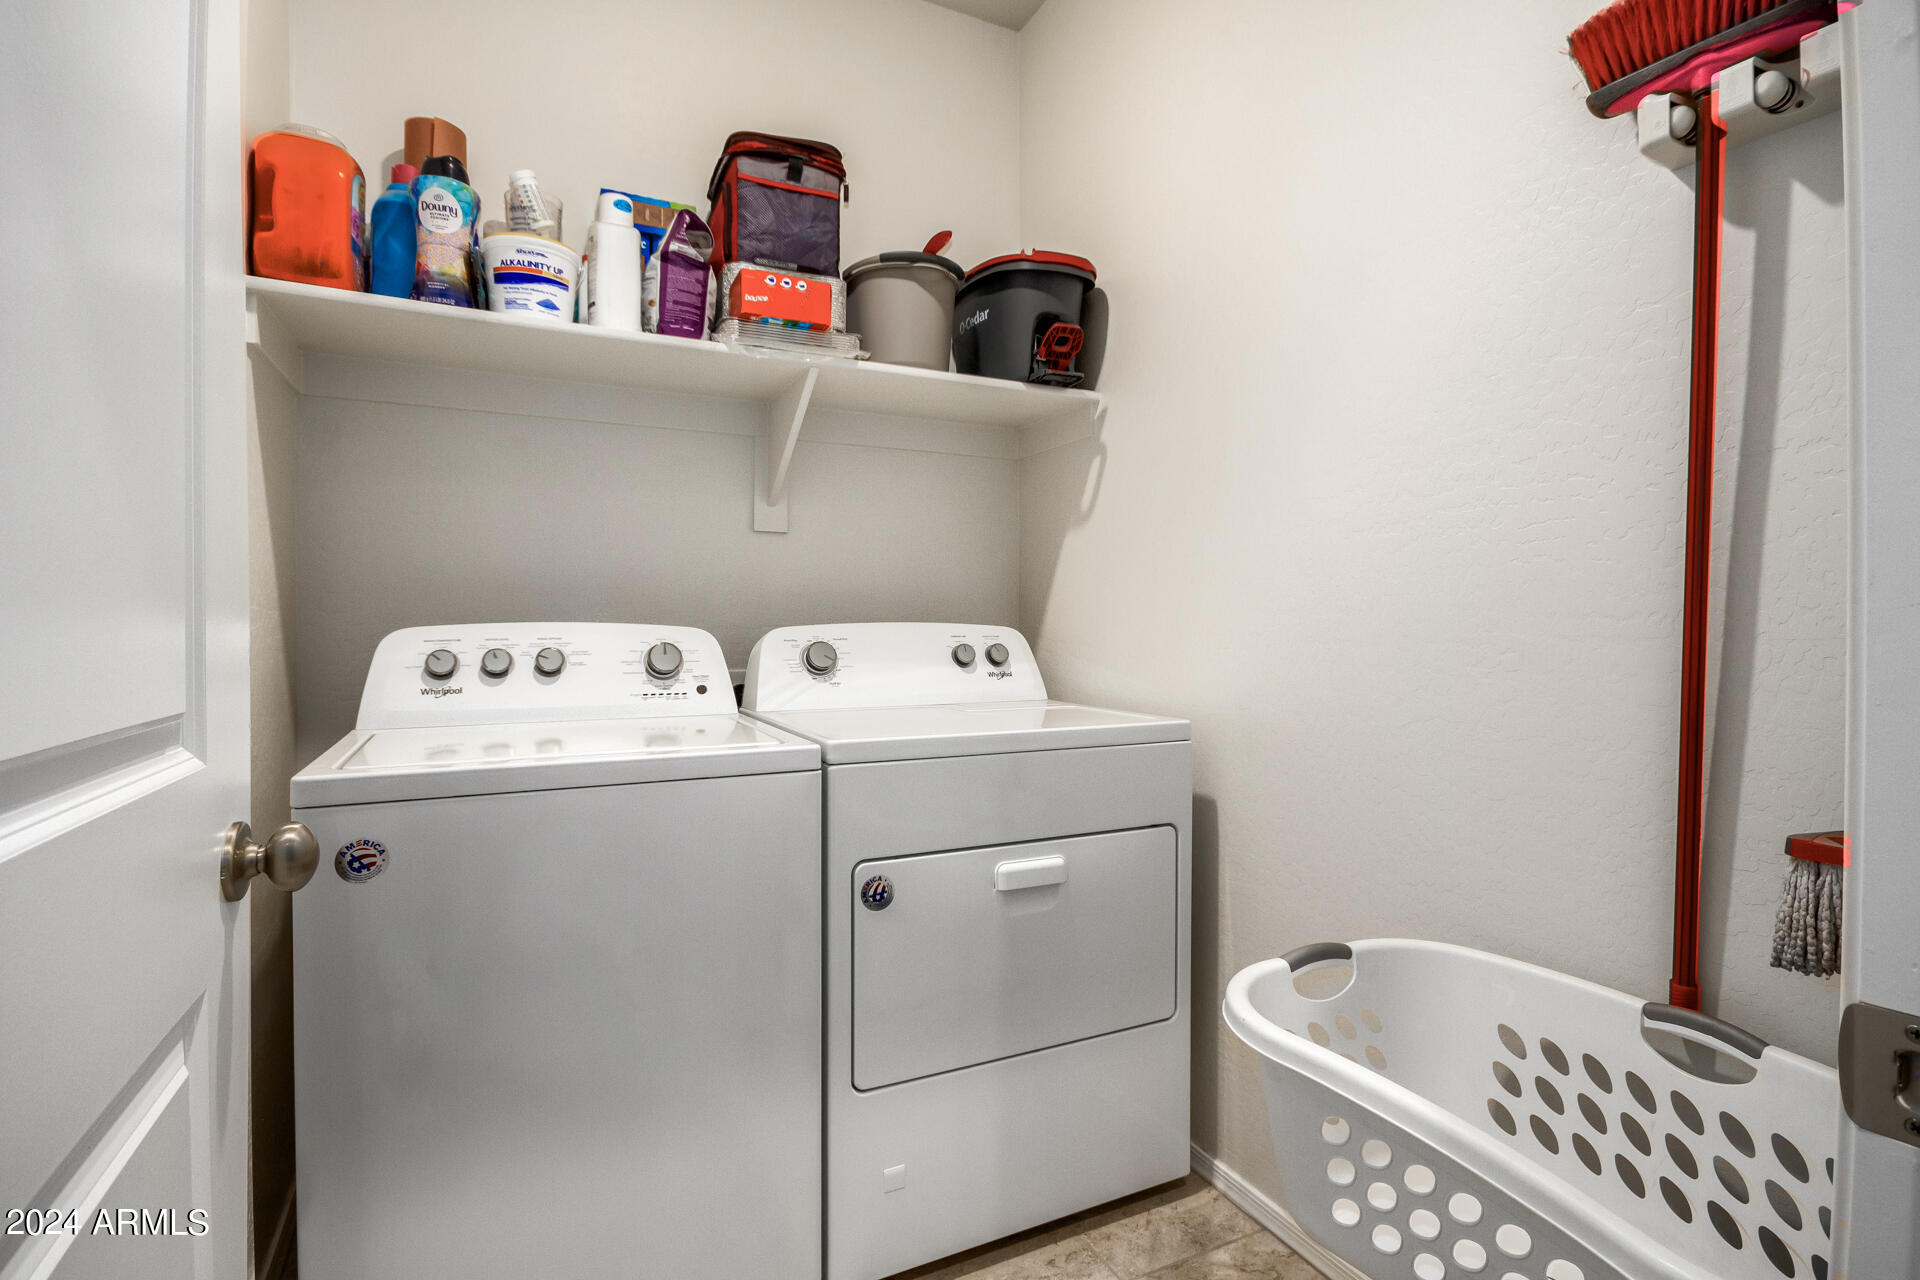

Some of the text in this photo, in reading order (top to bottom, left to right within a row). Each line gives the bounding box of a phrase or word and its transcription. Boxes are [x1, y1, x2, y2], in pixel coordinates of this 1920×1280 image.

[421, 200, 458, 218] Downy
[500, 258, 565, 276] ALKALINITY UP
[420, 686, 463, 698] Whirlpool
[339, 839, 386, 858] AMERICA
